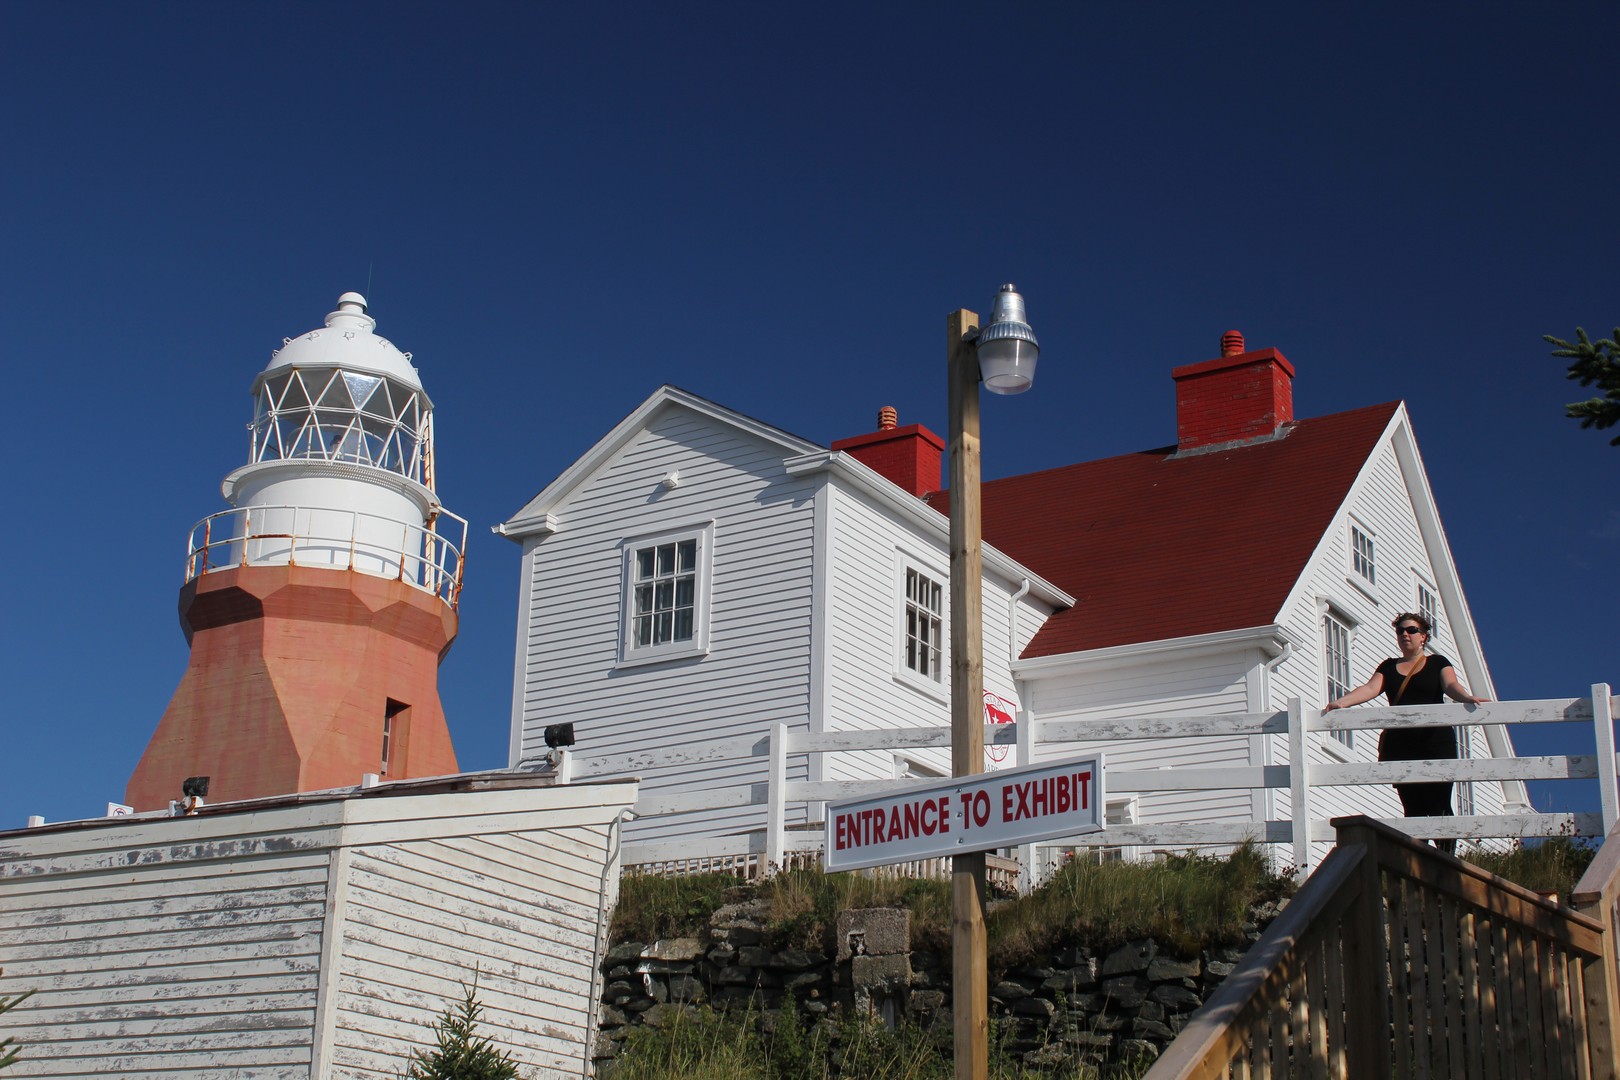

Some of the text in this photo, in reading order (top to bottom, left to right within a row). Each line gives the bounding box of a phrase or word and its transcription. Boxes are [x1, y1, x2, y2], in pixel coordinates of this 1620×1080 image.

[836, 771, 1091, 850] ENTRANCE TO EXHIBIT
